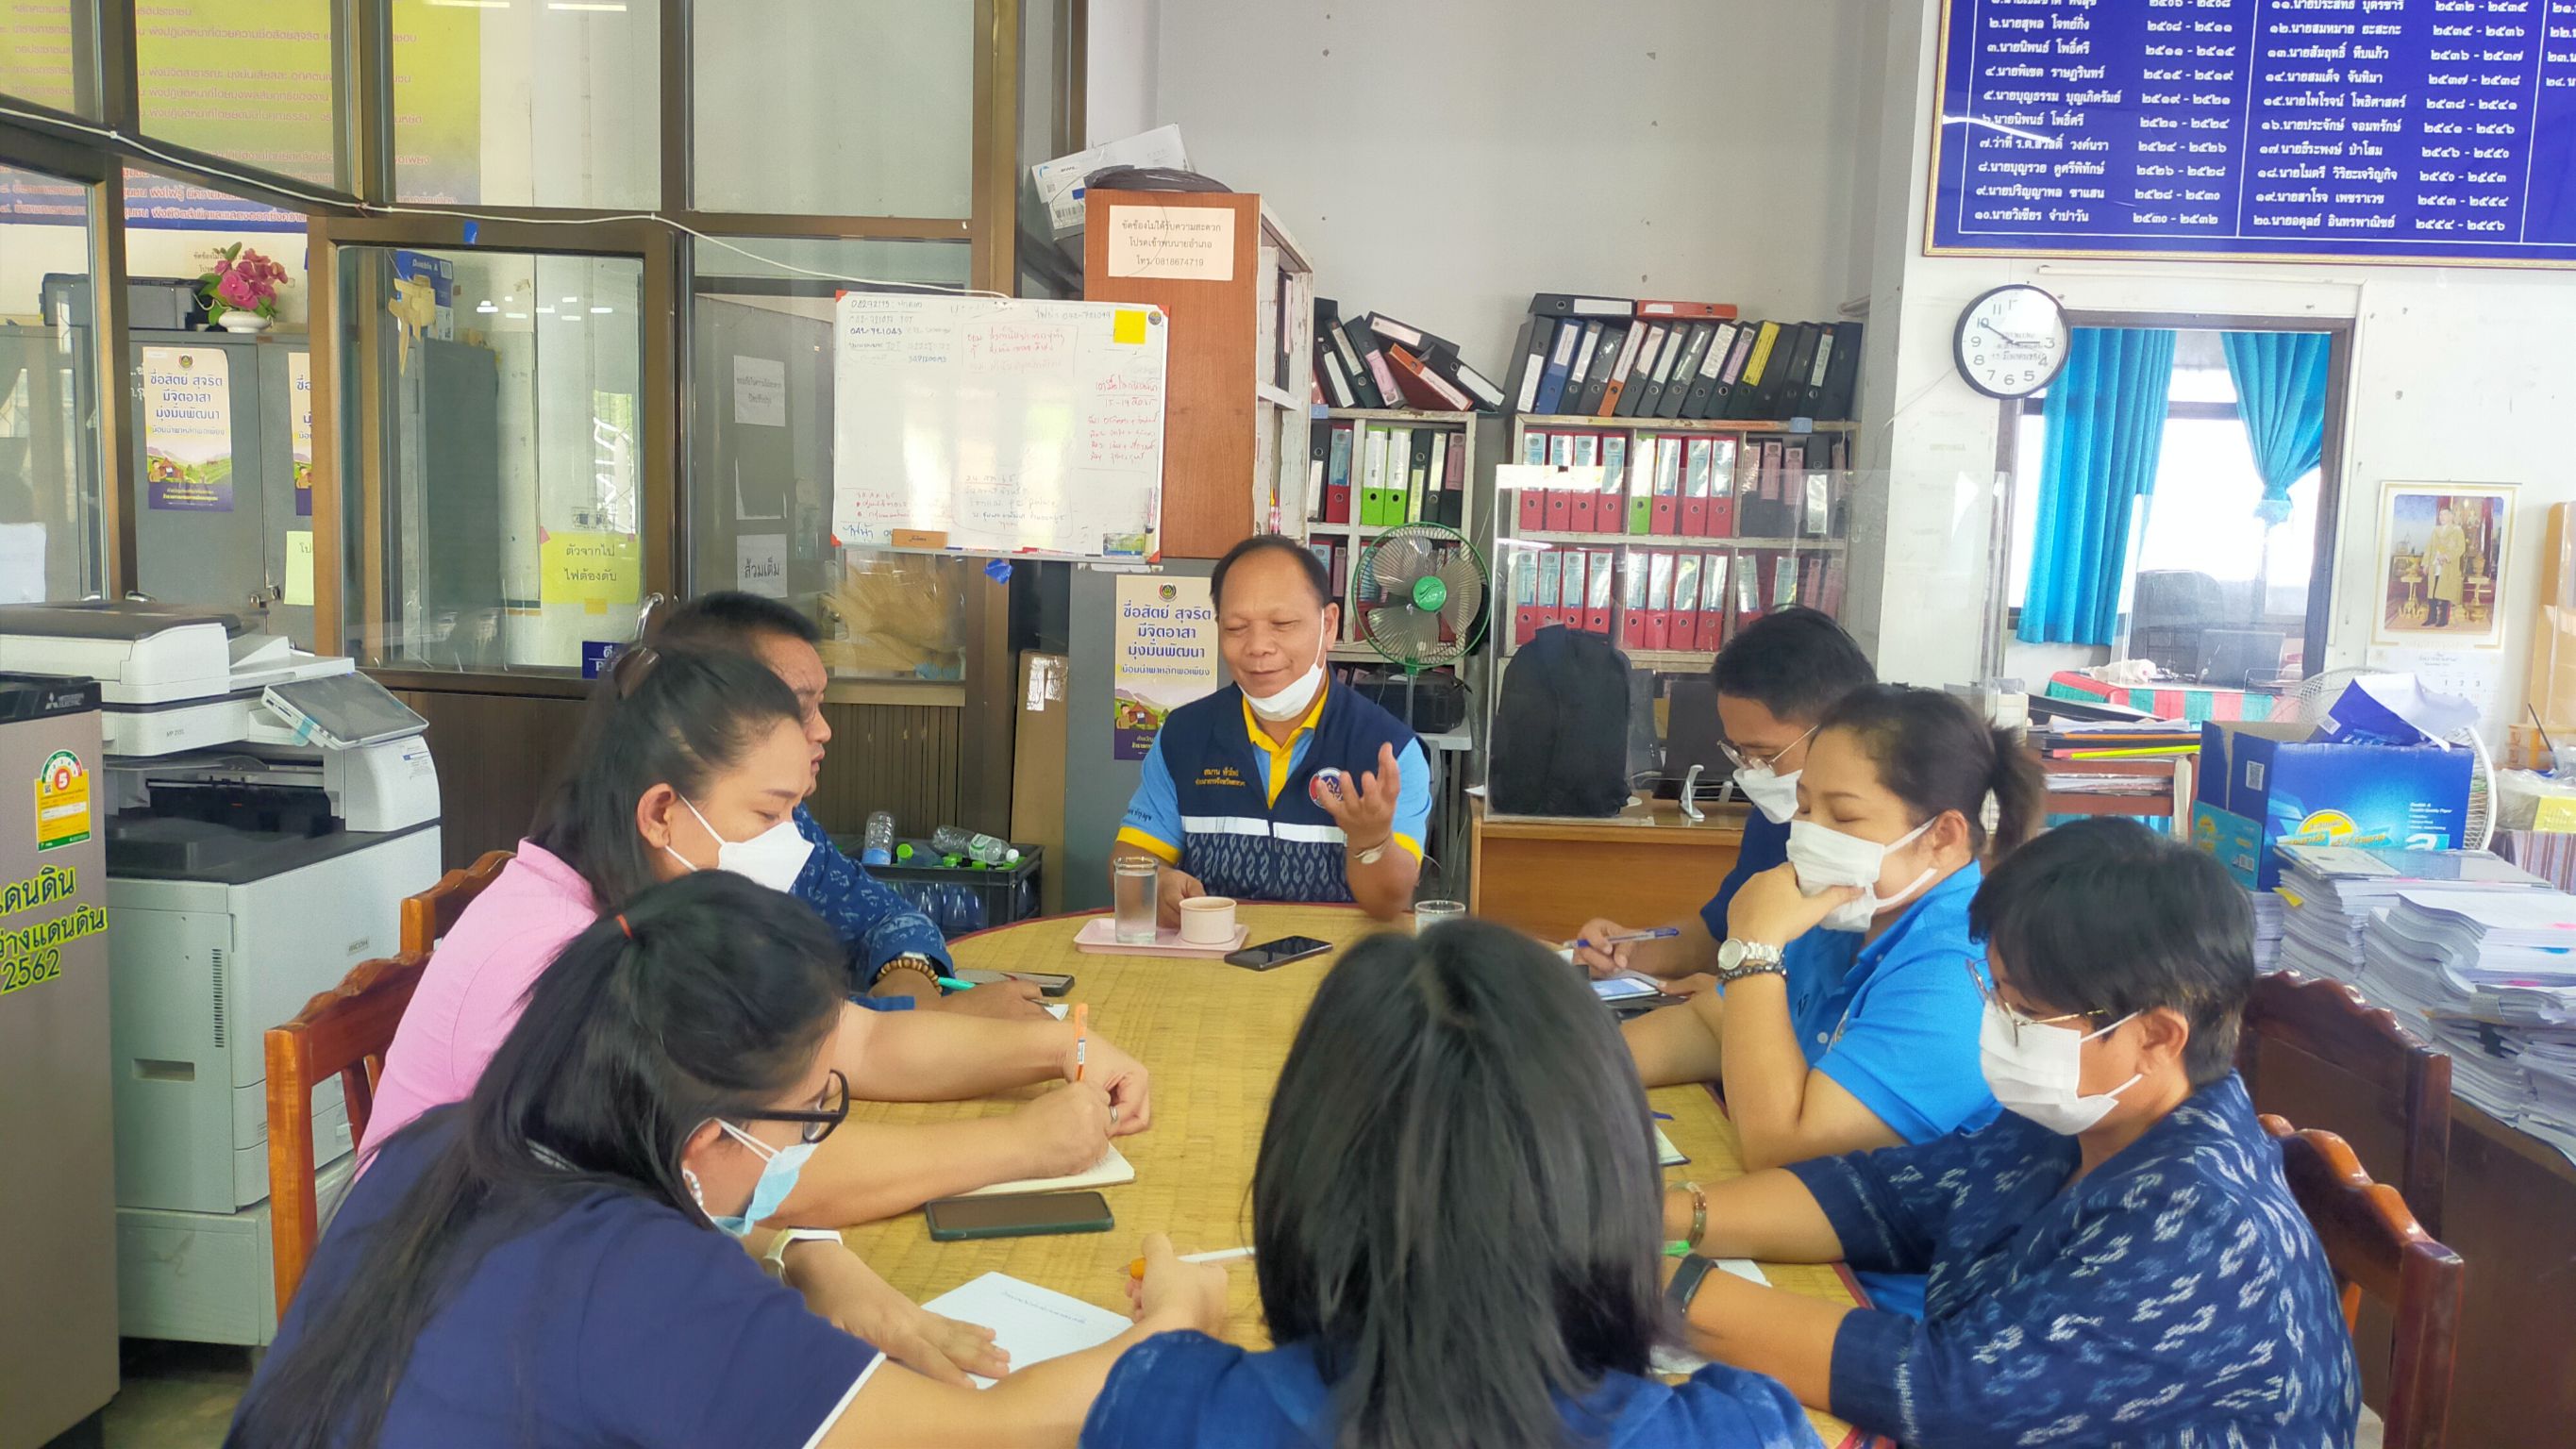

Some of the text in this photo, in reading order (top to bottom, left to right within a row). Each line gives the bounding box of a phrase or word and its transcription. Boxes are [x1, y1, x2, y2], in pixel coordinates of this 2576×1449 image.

[2148, 21, 2232, 32] ๒๕๐๘ ๒๕๑๑
[2434, 25, 2524, 36] ๒๕๓๕ ๒๕๓๖
[2055, 38, 2090, 54] โพธิ์ศรี
[2146, 45, 2235, 56] ๒๕๑๑ ๒๕๑๕
[2431, 50, 2523, 60] ๒๕๓๖ ๒๕๓๗
[2144, 69, 2233, 80] ๒๕๑๕ ๒๕๑๙
[2429, 75, 2520, 85] ๒๕๓๗ ๒๕๓๘
[1983, 91, 2059, 104] ๕.นายบุญธรรม
[2142, 93, 2230, 105] ๒๕๑๙ ๒๕๒๑
[2427, 98, 2517, 109] ๒๕๓๘ ๒๕๔๑
[2050, 109, 2083, 125] โพธิ์ศรี
[2140, 117, 2230, 128] ๒๕๒๑ ๒๕๒๔
[2424, 123, 2515, 134] ๒๕๔๑ ๒๕๔๖
[2138, 142, 2227, 153] ๒๕๒๔ ๒๕๒๖
[2422, 147, 2509, 158] ๒๕๔๖ ๒๕๕๐
[2136, 165, 2226, 176] ๒๕๒๖ ๒๕๒๘
[2419, 171, 2506, 182] ๒๕๕๐ ๒๕๕๓
[2135, 189, 2220, 200] ๒๕๒๘ ๒๕๓๐
[2418, 195, 2509, 207] ๒๕๕๓ ๒๕๕๔
[2133, 212, 2218, 225] ๒๕๓๐ ๒๕๓๒
[2416, 219, 2505, 230] ๒๕๕๔ ๒๕๕๖
[1155, 258, 1204, 266] 0818674719
[1970, 336, 1982, 347] 9
[2044, 337, 2055, 348] 3
[1973, 355, 1984, 366] 8
[1987, 370, 1996, 380] 7
[2003, 374, 2016, 385] 6
[2023, 370, 2035, 381] 5
[163, 389, 211, 403] มีจิตอาสา
[156, 404, 220, 422] มุ่งมั่นพัฒนา
[566, 544, 615, 558] ตัวจากไป
[564, 568, 617, 582] ไฟต้องดับ
[1175, 606, 1212, 624] สุจริต
[1138, 623, 1196, 641] มีจิตอาสา
[1128, 639, 1205, 660] มุ่งมั่นพัฒนา
[59, 773, 69, 788] 5
[3, 949, 59, 991] 2562
